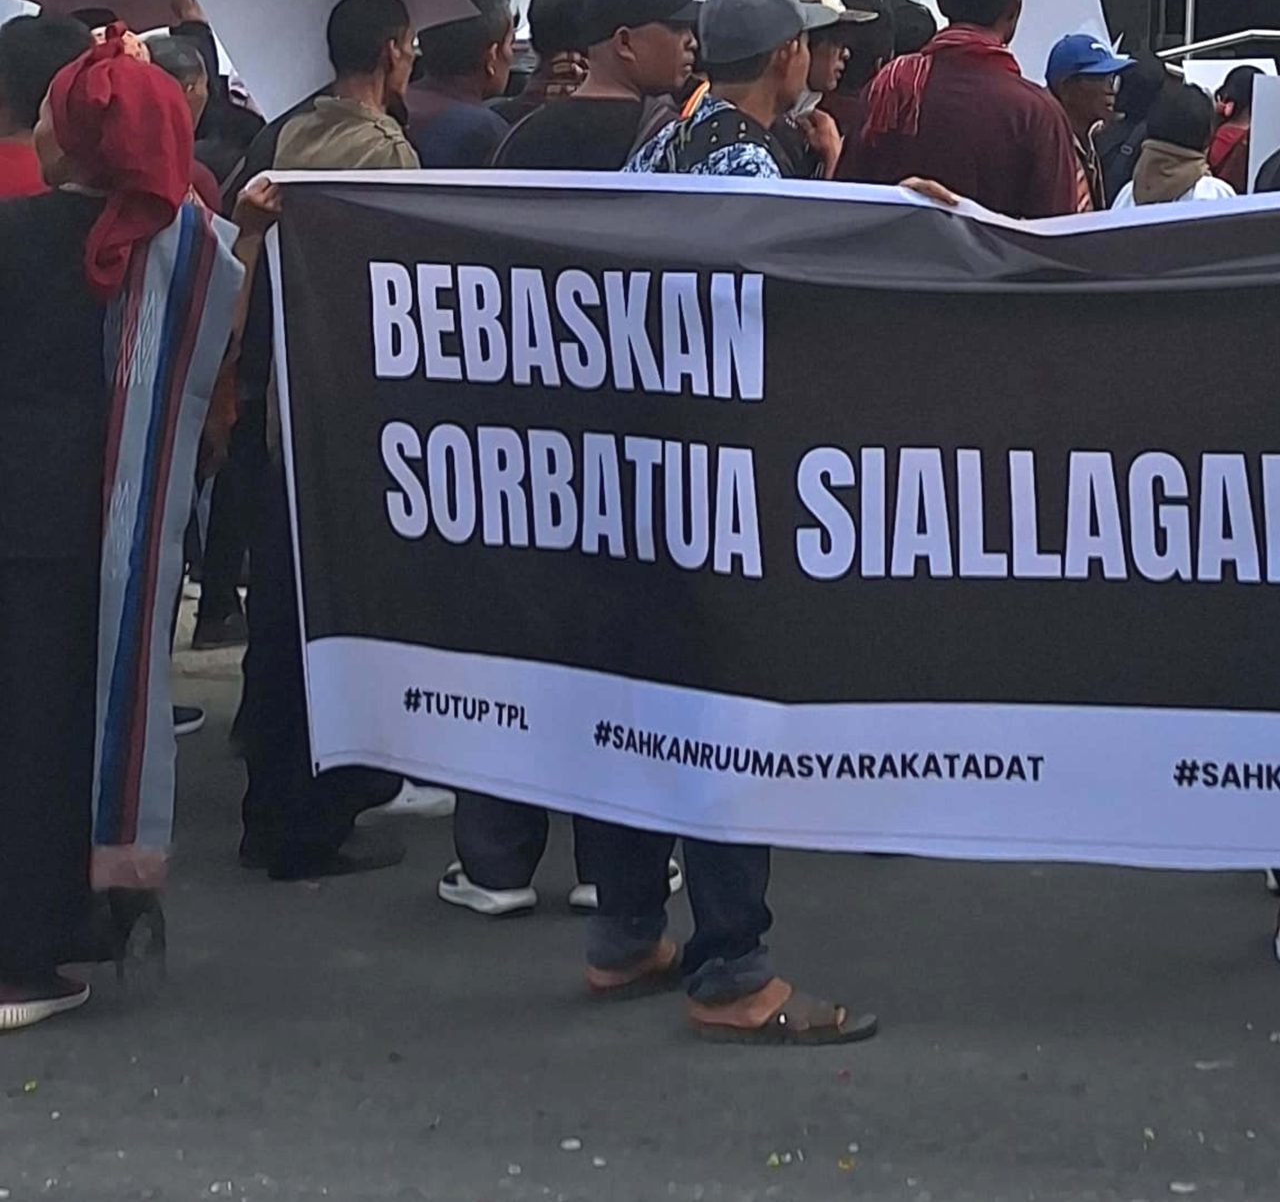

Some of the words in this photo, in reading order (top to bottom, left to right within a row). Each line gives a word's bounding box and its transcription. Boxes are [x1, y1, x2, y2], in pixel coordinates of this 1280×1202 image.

[369, 261, 764, 400] BEBASKAN
[381, 421, 763, 578] SORBATUA
[403, 687, 491, 722] #TUTUP
[493, 700, 529, 731] TPL
[593, 719, 1044, 782] #SAHKANRUUMASYARAKATADAT
